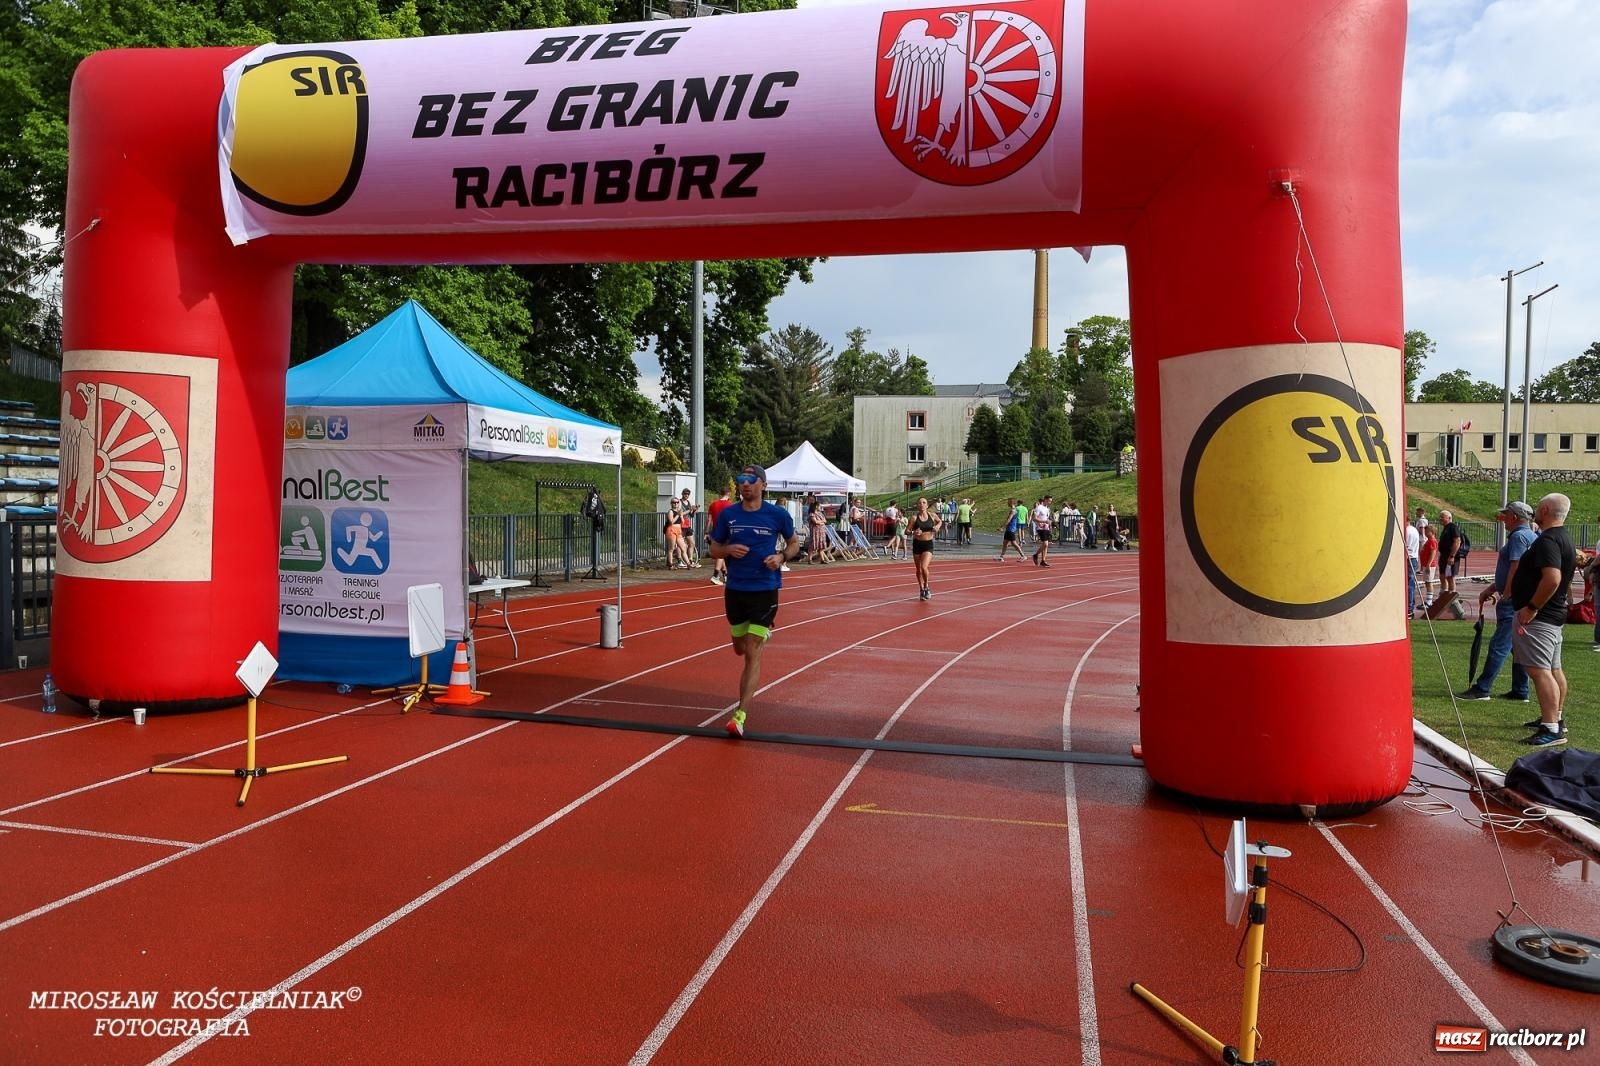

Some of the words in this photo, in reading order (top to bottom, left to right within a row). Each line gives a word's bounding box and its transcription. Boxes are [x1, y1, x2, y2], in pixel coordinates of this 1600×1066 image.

[524, 26, 692, 65] BIEG
[290, 65, 367, 98] SIR
[411, 89, 539, 139] BEZ
[546, 71, 800, 133] GRANIC
[452, 143, 766, 210] RACIBÓRZ
[413, 426, 445, 437] MITKO
[480, 418, 545, 445] PersonalBest
[1291, 415, 1393, 464] SIR
[283, 469, 390, 502] nalBest
[279, 574, 324, 585] ZJOTERAPIA
[342, 577, 380, 588] TRENINGI
[342, 589, 381, 600] BIEGOWE
[279, 601, 385, 624] rsonalbest.pl
